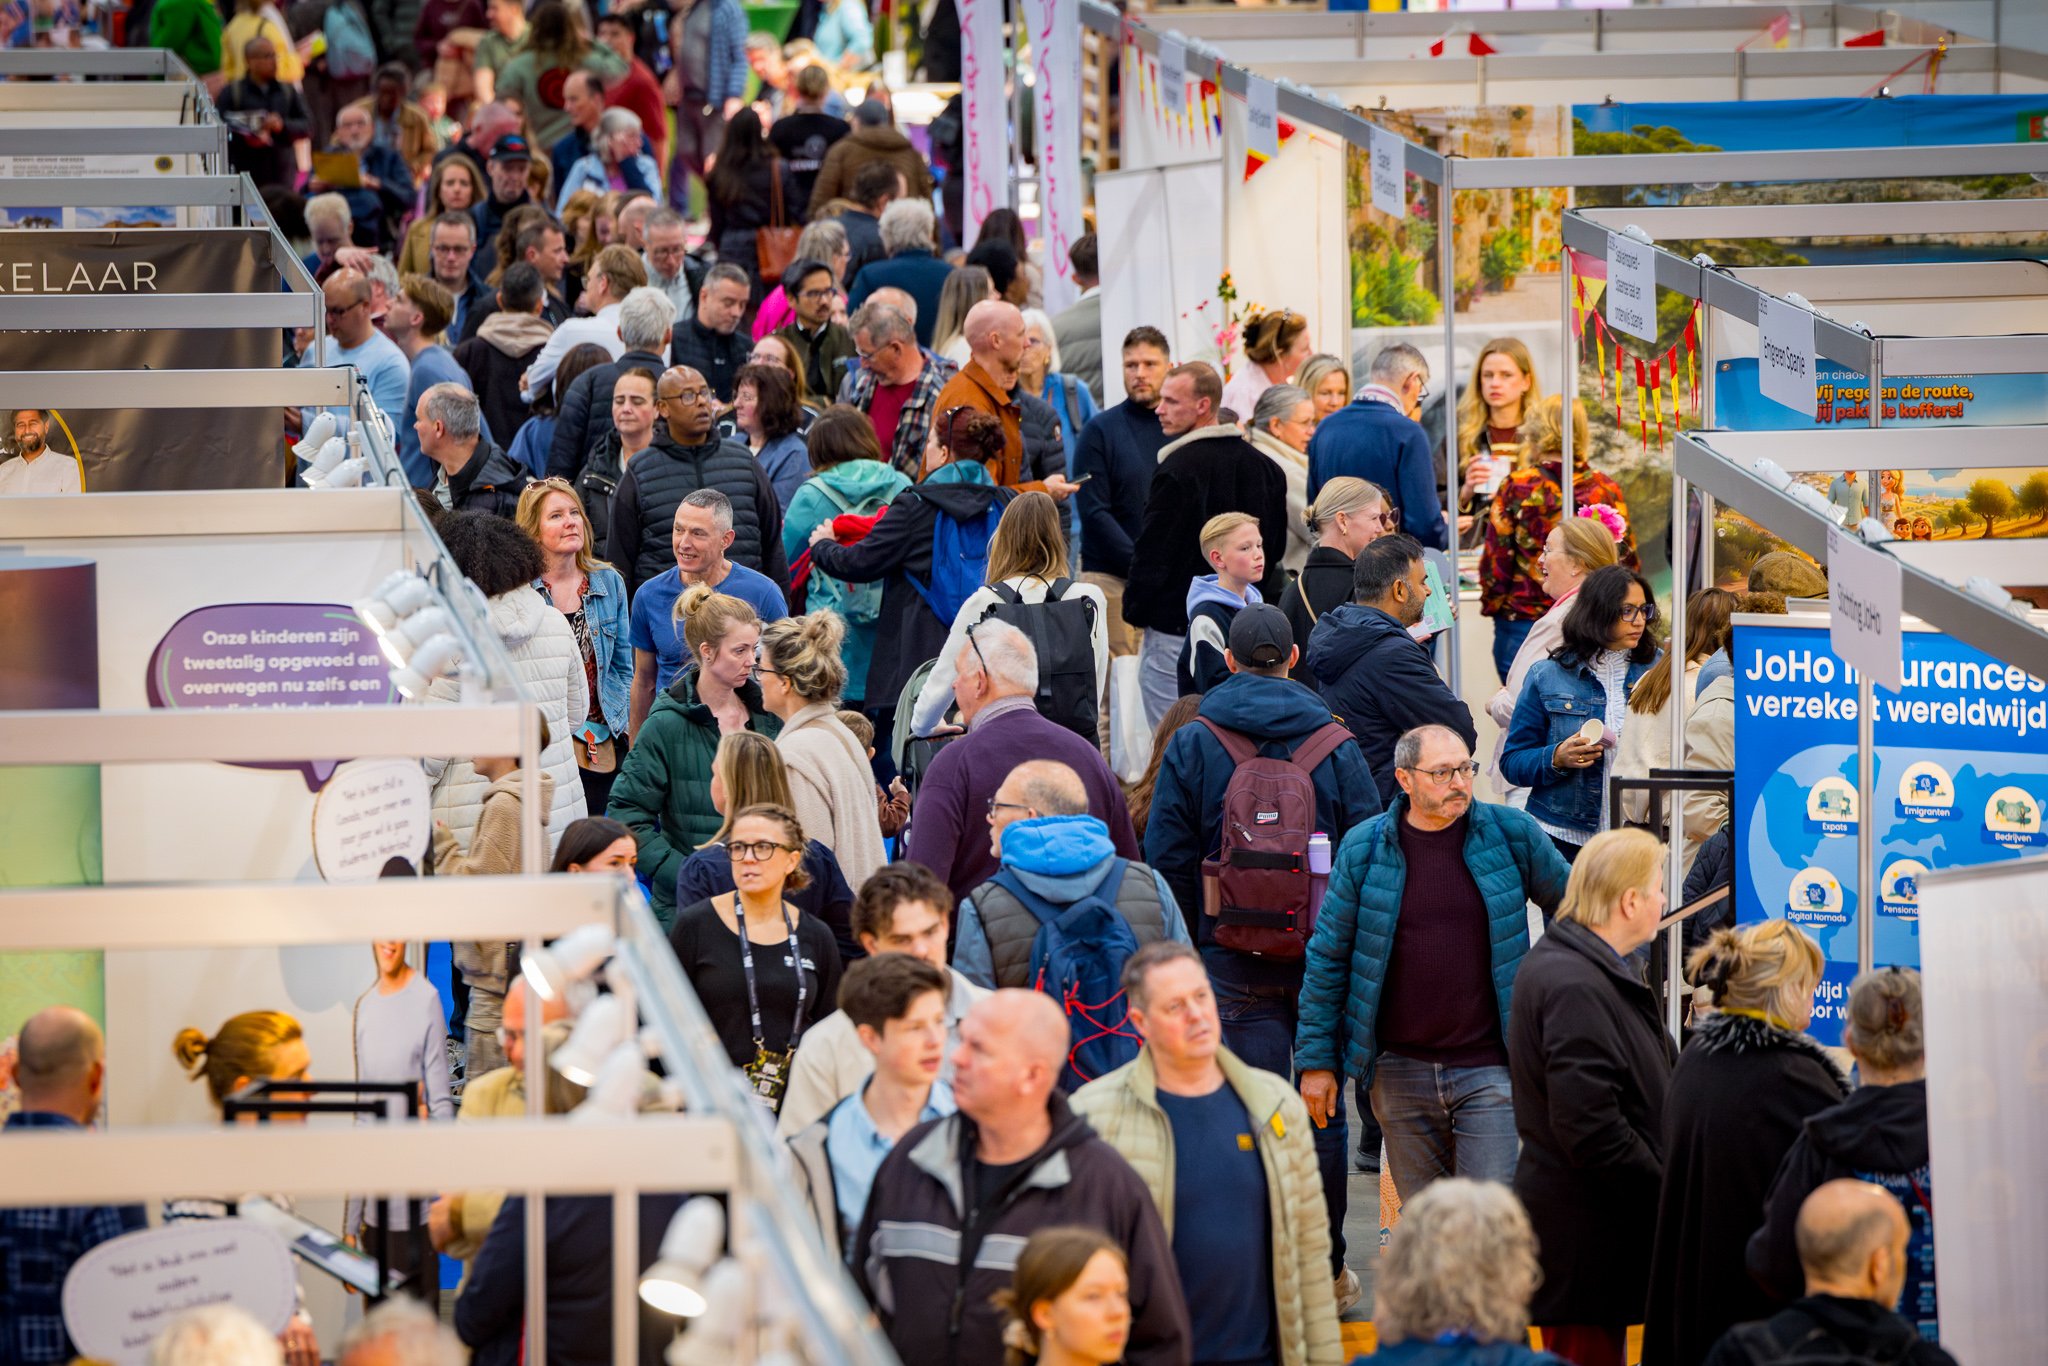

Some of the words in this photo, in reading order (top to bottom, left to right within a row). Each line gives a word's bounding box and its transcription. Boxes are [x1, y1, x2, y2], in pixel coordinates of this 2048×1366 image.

[1837, 387, 1897, 403] regeen
[1901, 384, 1921, 399] de
[1924, 383, 1975, 400] route,
[1900, 402, 1964, 419] koffers!
[203, 630, 247, 645] Onze
[250, 628, 326, 645] kinderen
[329, 628, 359, 645] zijn
[184, 655, 264, 672] tweetalig
[269, 653, 353, 671] opgevoed
[357, 654, 380, 667] en
[1745, 648, 1835, 684] JoHo
[1844, 660, 2046, 693] Iurances
[183, 681, 277, 696] overwegen
[281, 679, 304, 693] nu
[306, 676, 347, 692] zelfs
[348, 678, 382, 691] een
[1745, 691, 1881, 721] verzeket
[1886, 696, 2047, 737] wereldwijd
[1904, 806, 1951, 819] Emigranten
[1821, 821, 1849, 834] Expats
[1994, 831, 2033, 844] Bedrijven
[1787, 911, 1813, 923] Digital
[1813, 913, 1848, 923] Nomads
